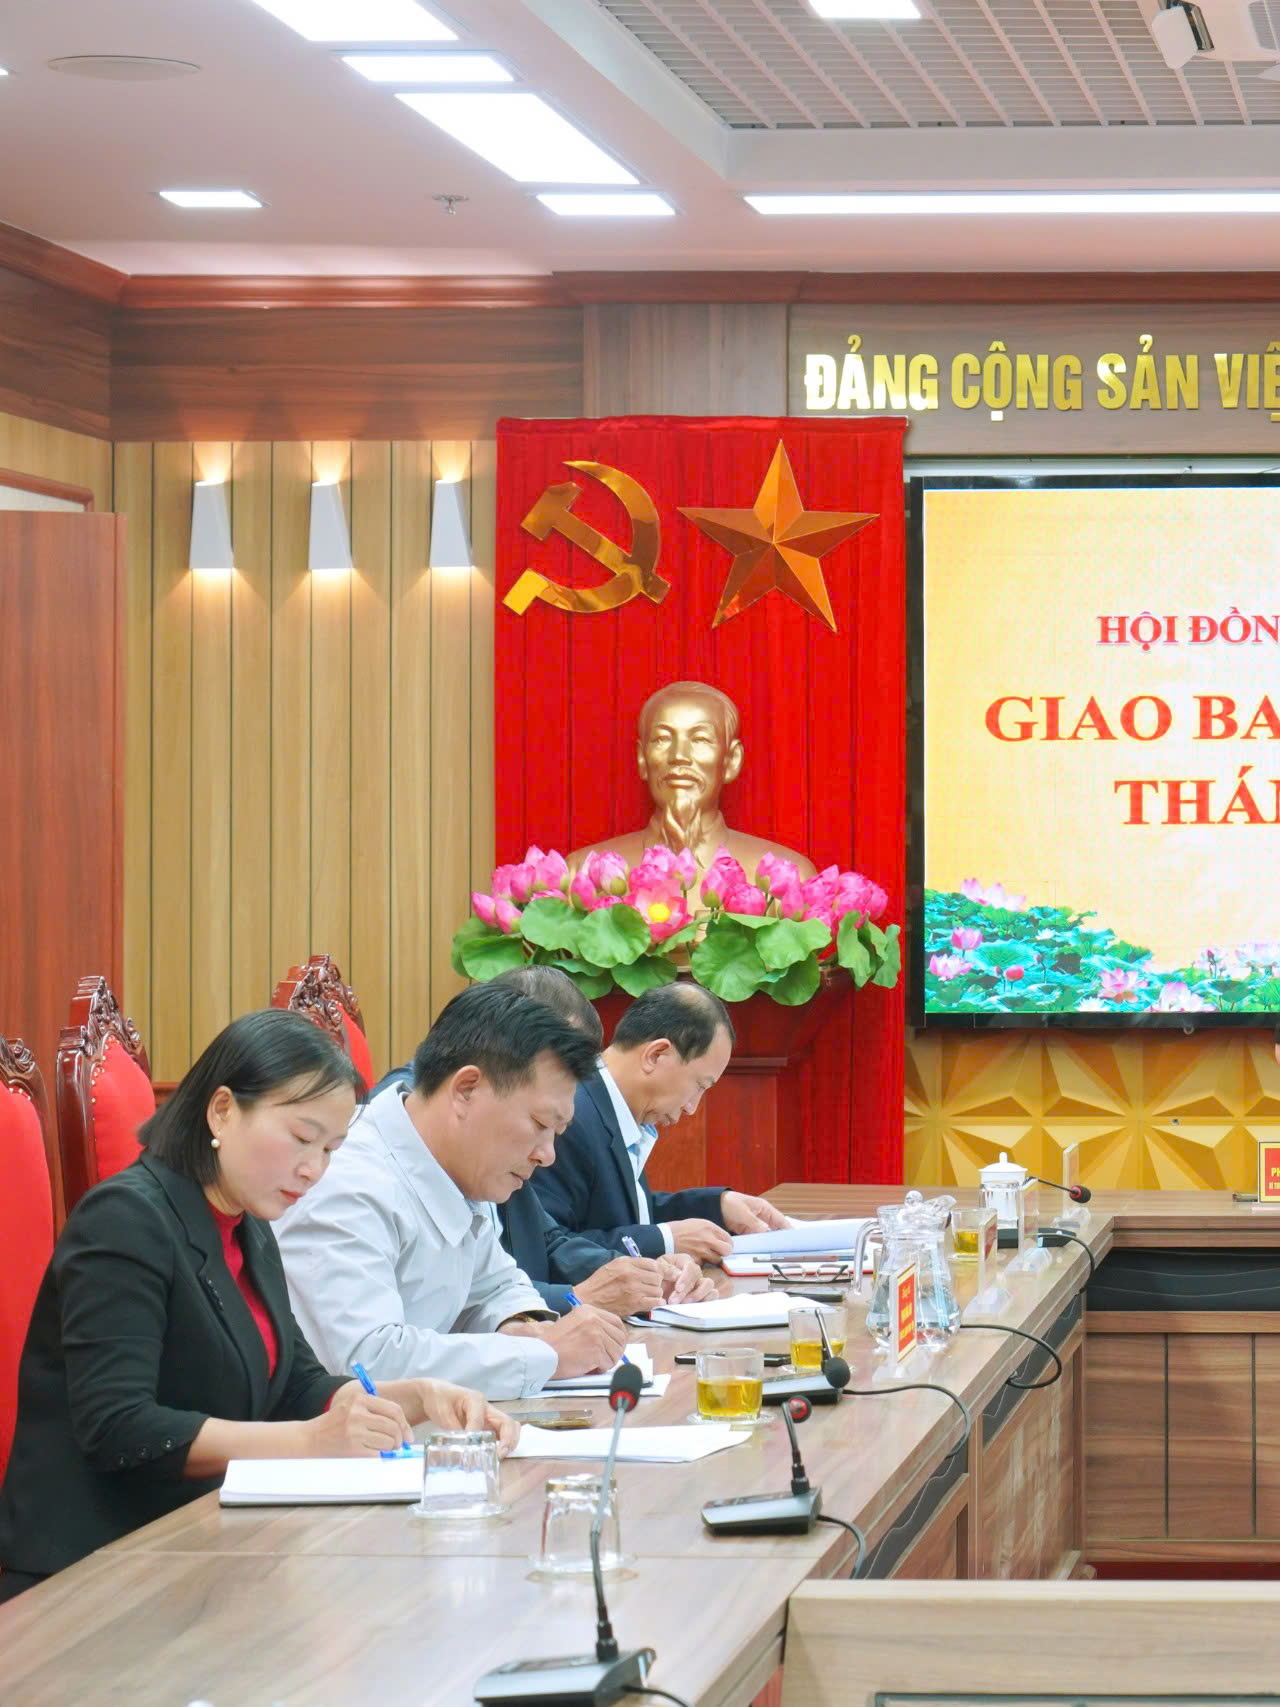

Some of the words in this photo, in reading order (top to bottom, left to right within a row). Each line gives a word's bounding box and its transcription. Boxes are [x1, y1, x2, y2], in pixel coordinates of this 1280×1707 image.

[805, 335, 938, 410] ĐẢNG
[952, 341, 1082, 421] CỘNG
[1097, 334, 1199, 410] SẢN
[1099, 612, 1177, 652] HỘI
[985, 695, 1172, 741] GIAO
